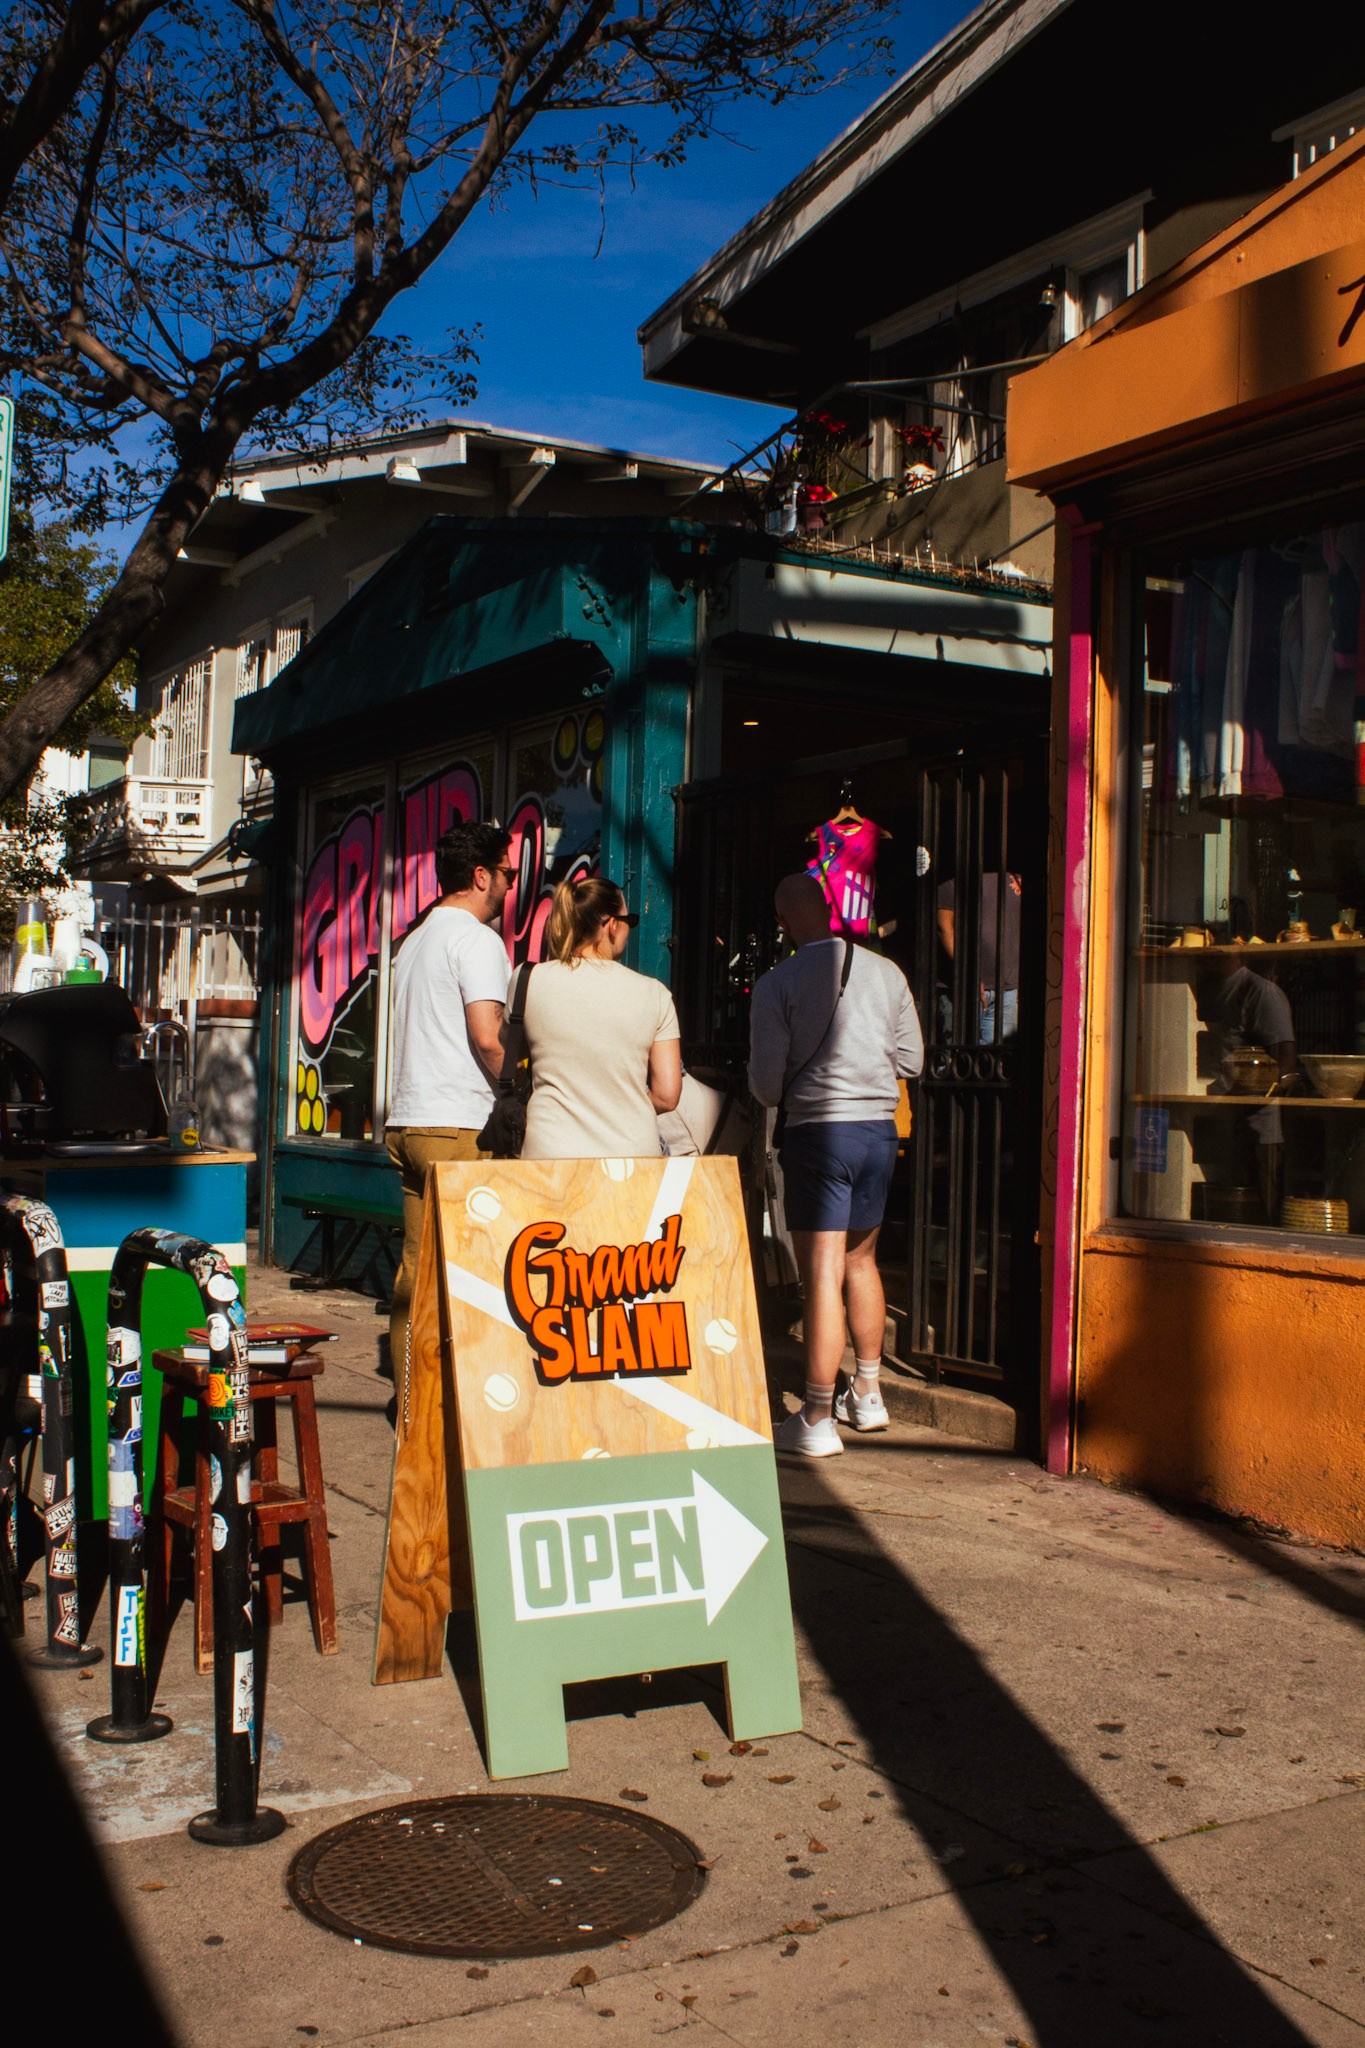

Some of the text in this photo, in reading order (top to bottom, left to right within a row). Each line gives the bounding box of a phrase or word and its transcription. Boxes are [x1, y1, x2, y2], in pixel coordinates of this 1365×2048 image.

[505, 1215, 685, 1328] Grand
[533, 1301, 692, 1386] SLAM
[209, 1406, 235, 1418] ARKET
[519, 1505, 706, 1609] OPEN
